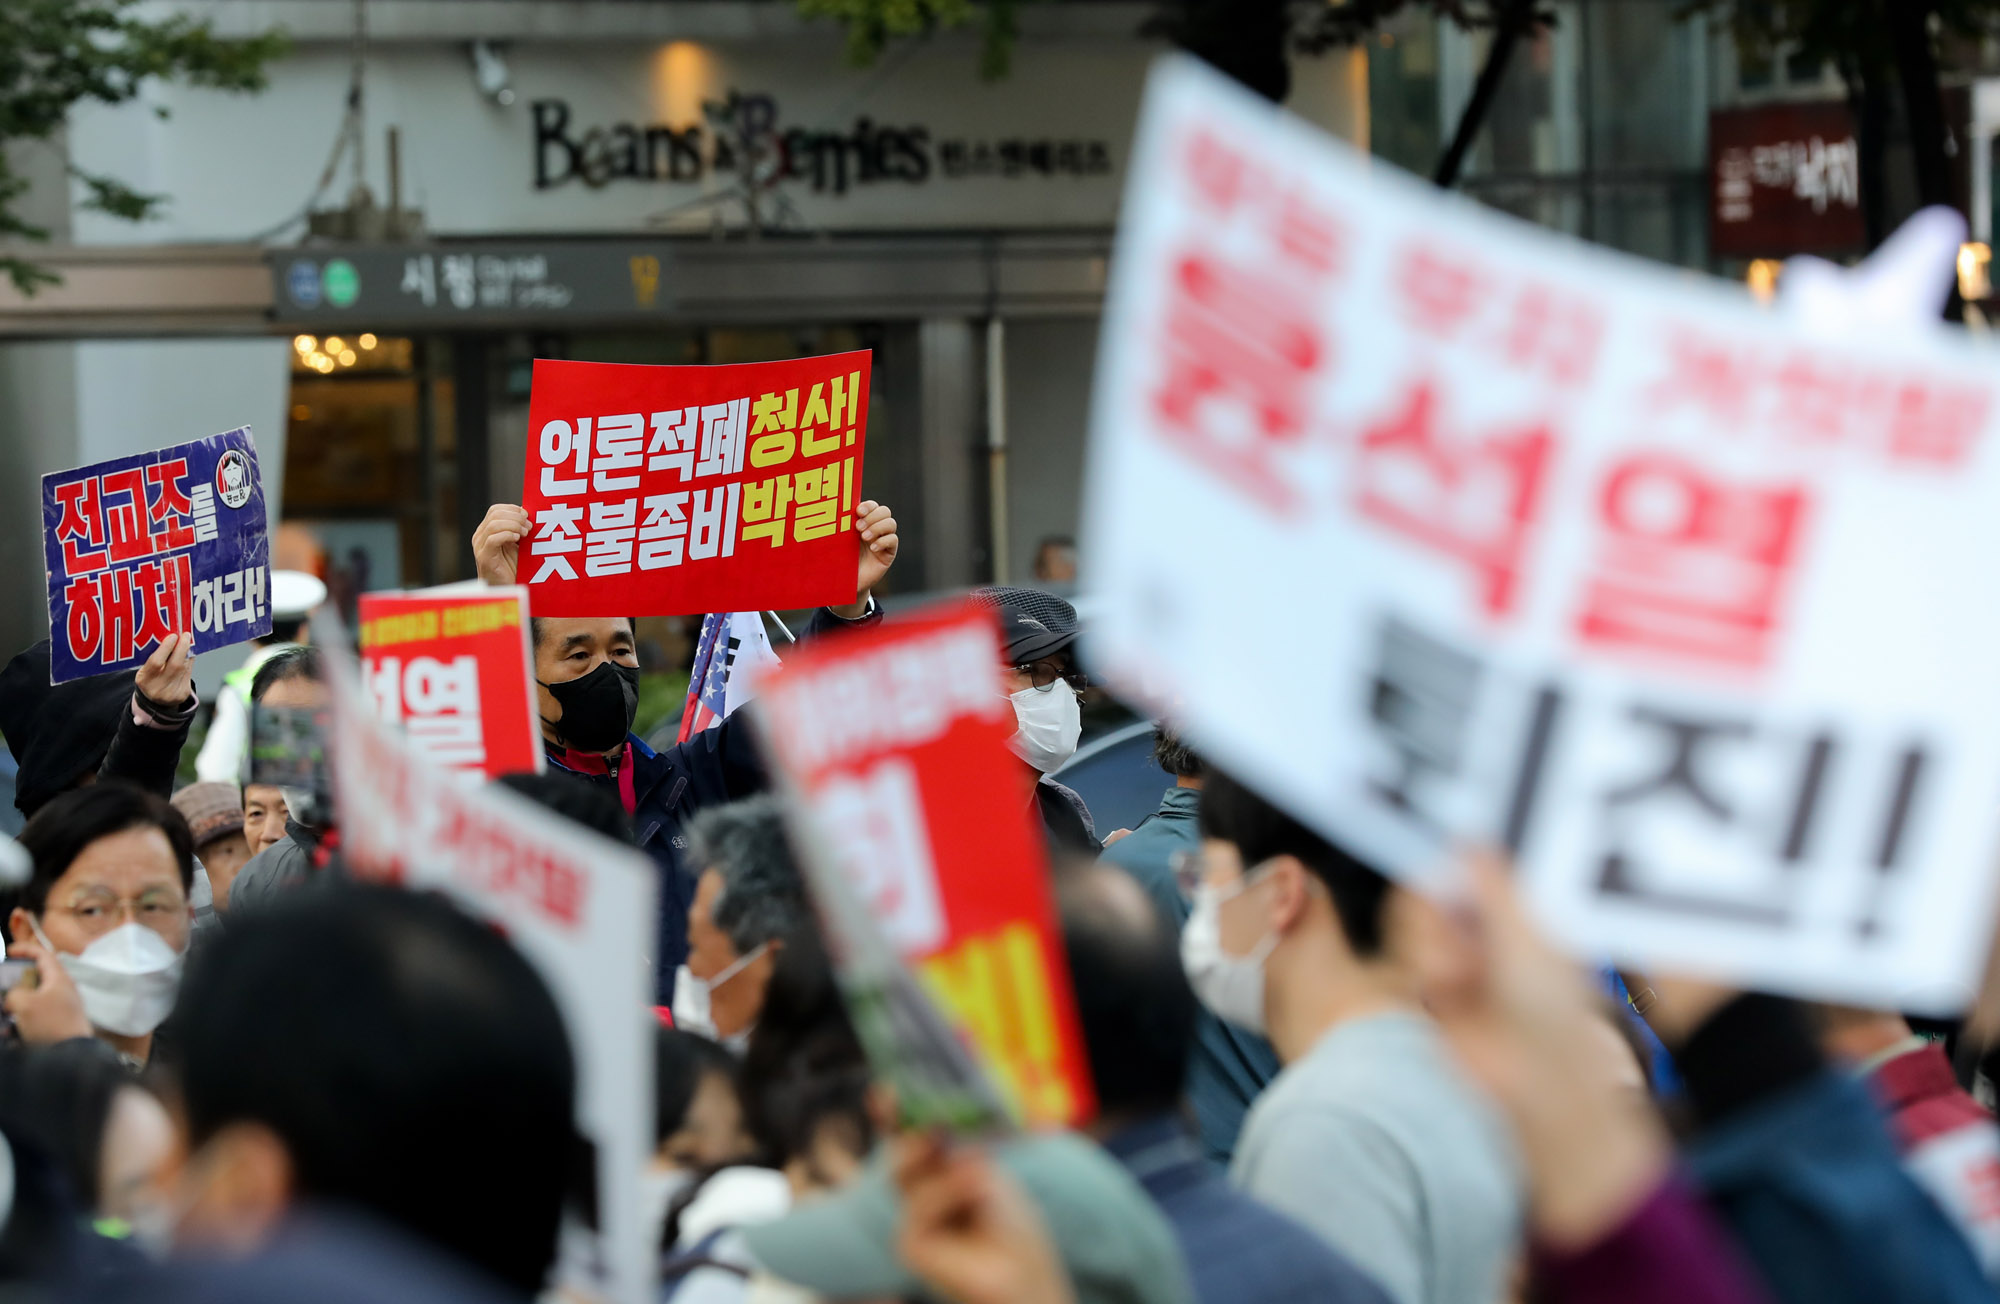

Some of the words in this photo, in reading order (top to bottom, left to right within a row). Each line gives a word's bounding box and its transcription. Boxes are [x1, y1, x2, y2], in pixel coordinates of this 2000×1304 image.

[531, 98, 700, 191] Beans
[54, 457, 220, 576] 전교조를
[1144, 243, 1820, 680] 윤석열
[64, 552, 266, 666] 해체하라!
[1360, 612, 1937, 945] 퇴진!
